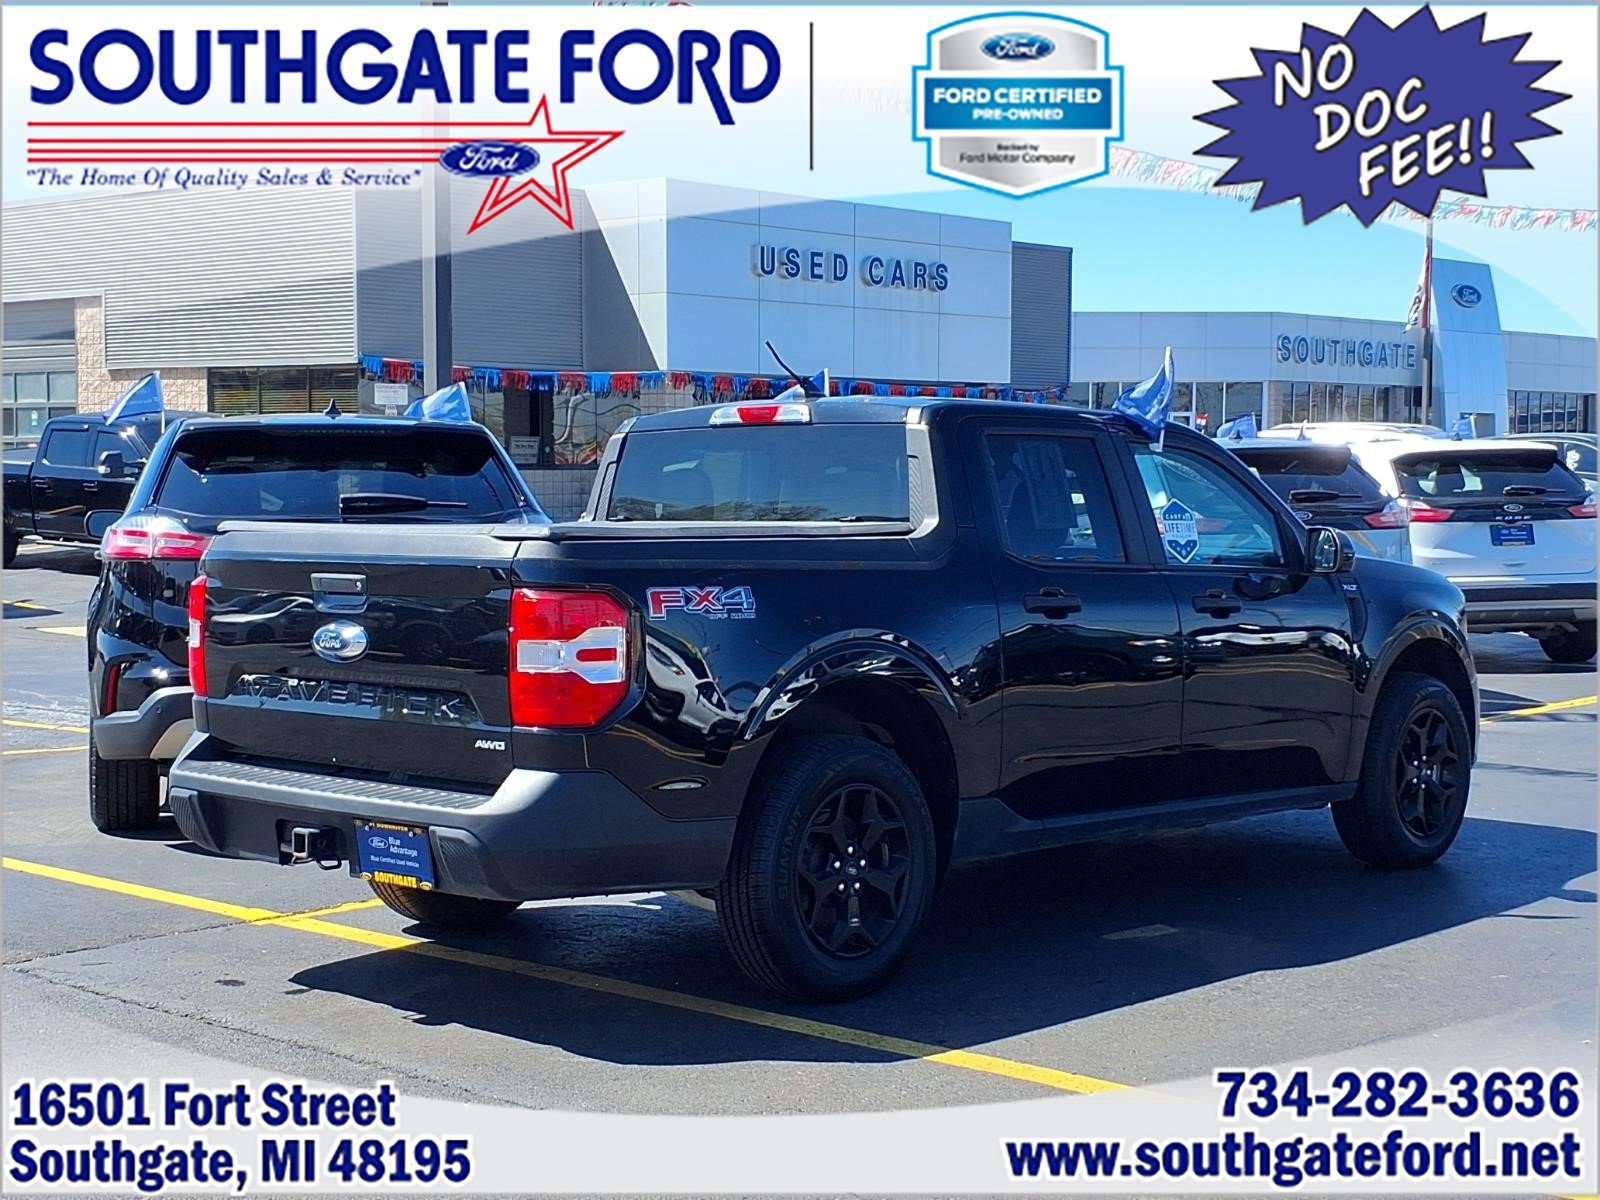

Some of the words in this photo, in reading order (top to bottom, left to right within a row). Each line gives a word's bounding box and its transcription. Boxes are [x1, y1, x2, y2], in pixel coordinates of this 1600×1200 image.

[757, 245, 849, 283] USED
[864, 255, 950, 292] CARS
[1277, 334, 1417, 370] SOUTHGATE
[645, 586, 756, 621] FX4
[474, 738, 506, 751] AWD
[388, 836, 400, 845] Blue
[390, 845, 418, 857] Advantage
[374, 871, 417, 888] SOUTHGATE
